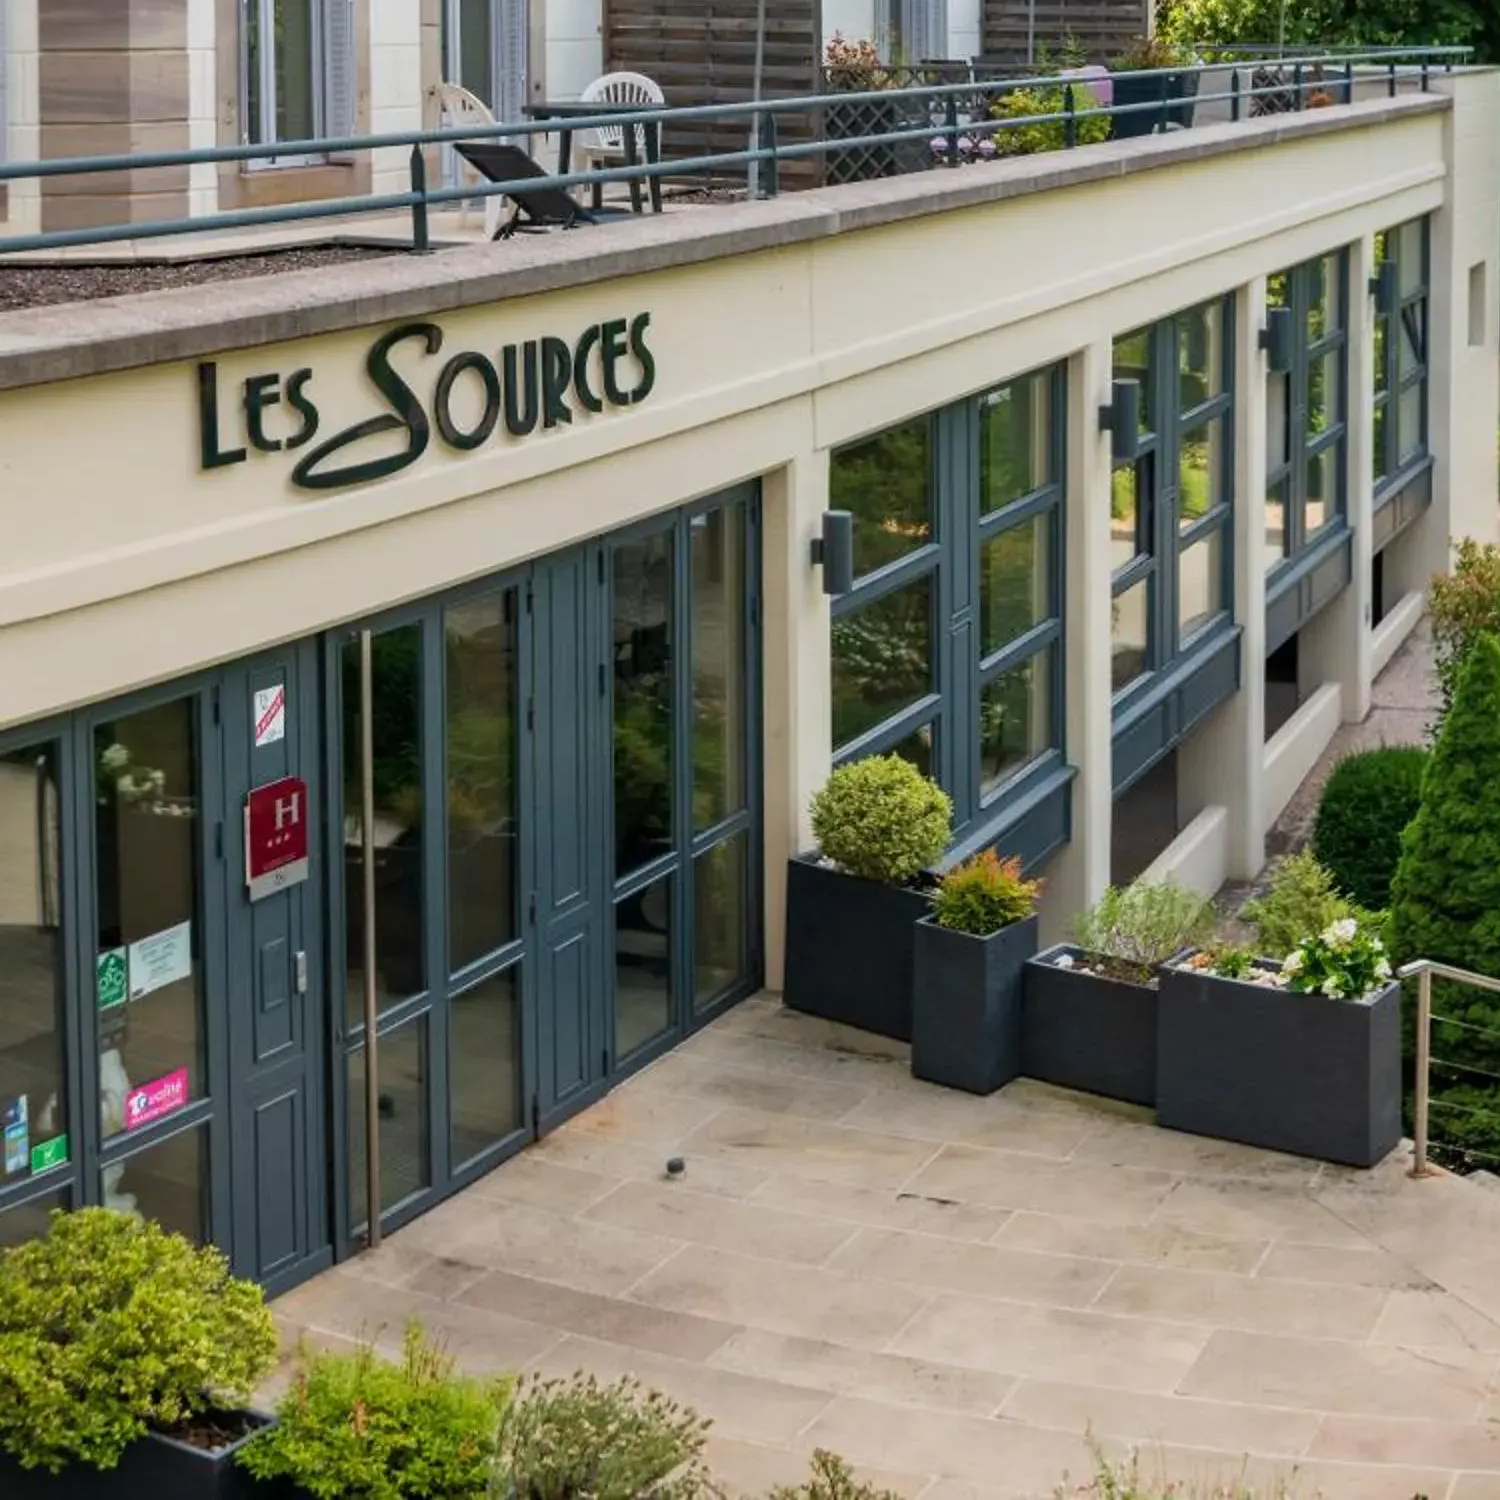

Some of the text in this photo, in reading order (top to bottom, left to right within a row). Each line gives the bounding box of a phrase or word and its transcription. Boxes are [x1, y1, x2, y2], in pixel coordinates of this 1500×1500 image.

[198, 312, 655, 488] LES SOURCES
[275, 792, 299, 830] H
